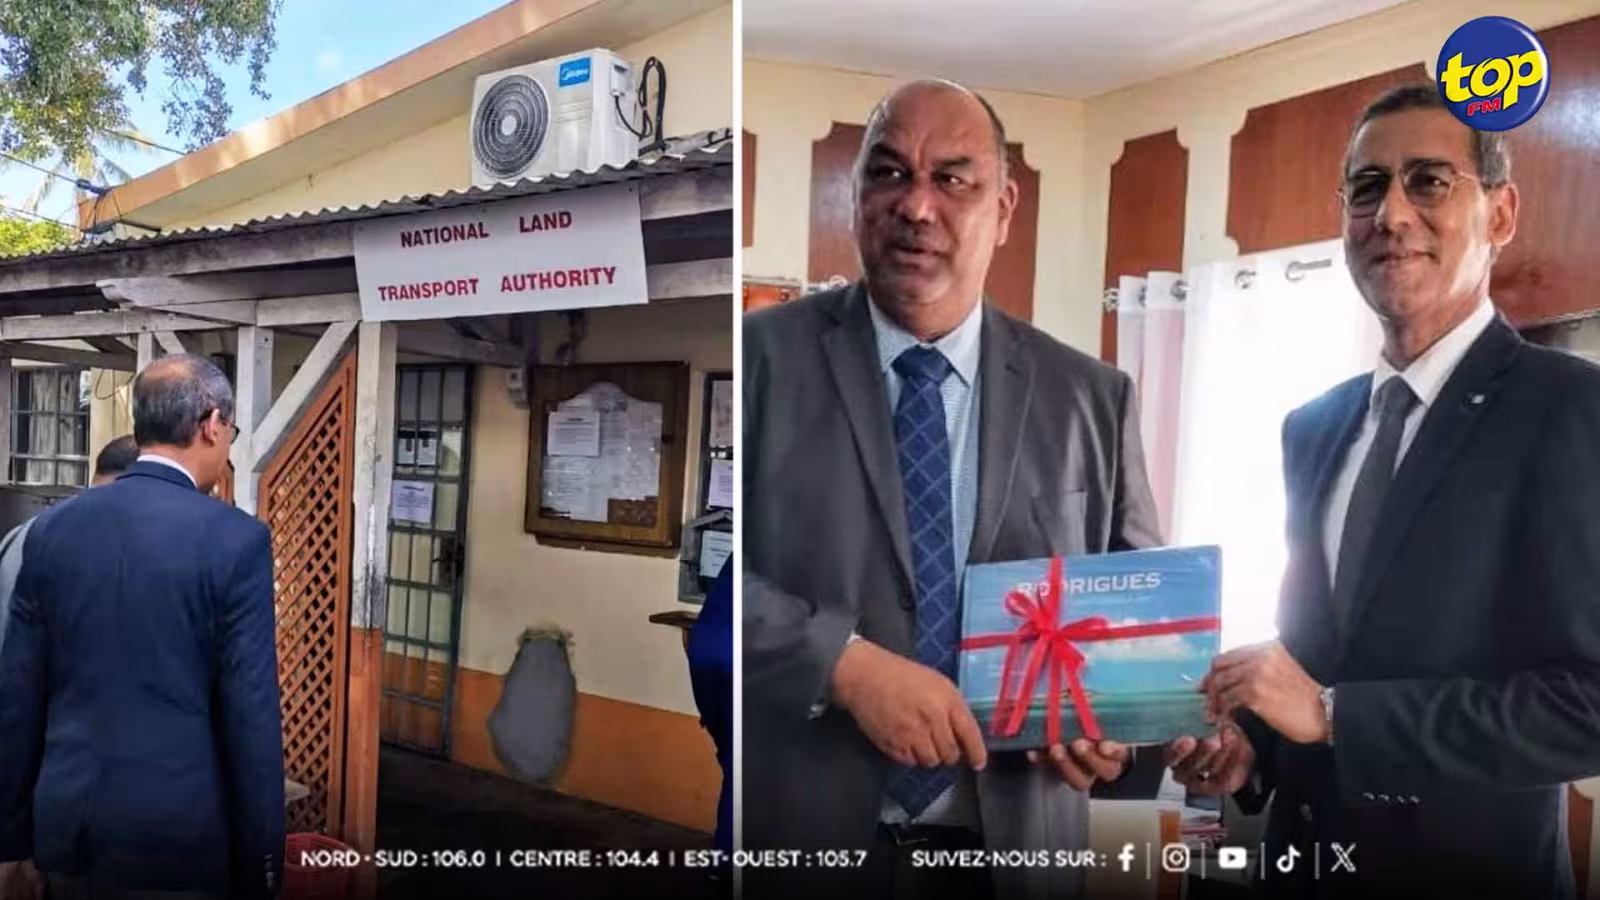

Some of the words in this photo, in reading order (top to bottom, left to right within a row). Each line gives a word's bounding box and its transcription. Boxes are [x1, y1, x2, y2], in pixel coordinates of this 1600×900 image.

[400, 221, 490, 249] NATIONAL
[519, 210, 573, 234] LAND
[378, 278, 479, 302] TRANSPORT
[500, 266, 617, 293] AUTHORITY
[1016, 571, 1162, 596] RORIGUES
